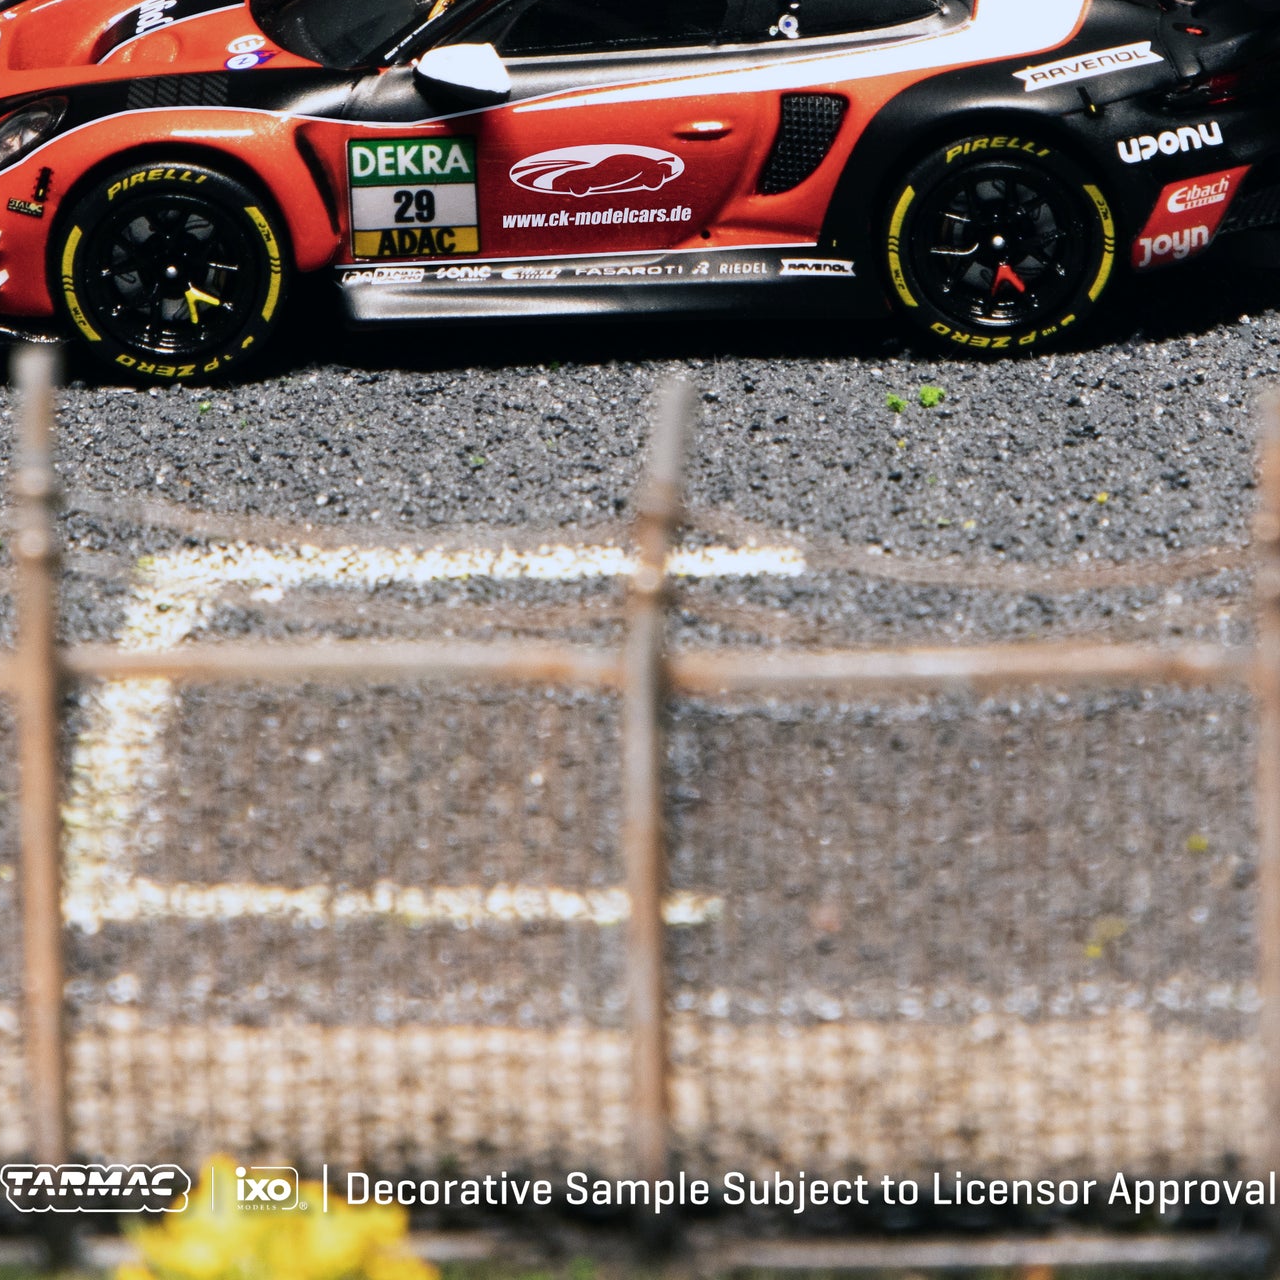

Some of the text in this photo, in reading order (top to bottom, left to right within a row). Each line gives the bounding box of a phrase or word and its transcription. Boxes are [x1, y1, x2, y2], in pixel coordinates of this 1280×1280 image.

[1030, 51, 1147, 83] RAVENOL
[352, 144, 471, 178] DEKRA
[945, 136, 1051, 164] PIRELLI
[107, 169, 208, 201] PIRELLI
[394, 190, 436, 222] 29
[502, 205, 692, 229] www.ck-modelcars.de
[378, 228, 457, 255] ADAC
[719, 263, 768, 275] RIEDEL
[930, 322, 1013, 349] ZERO
[115, 354, 197, 378] ZERO
